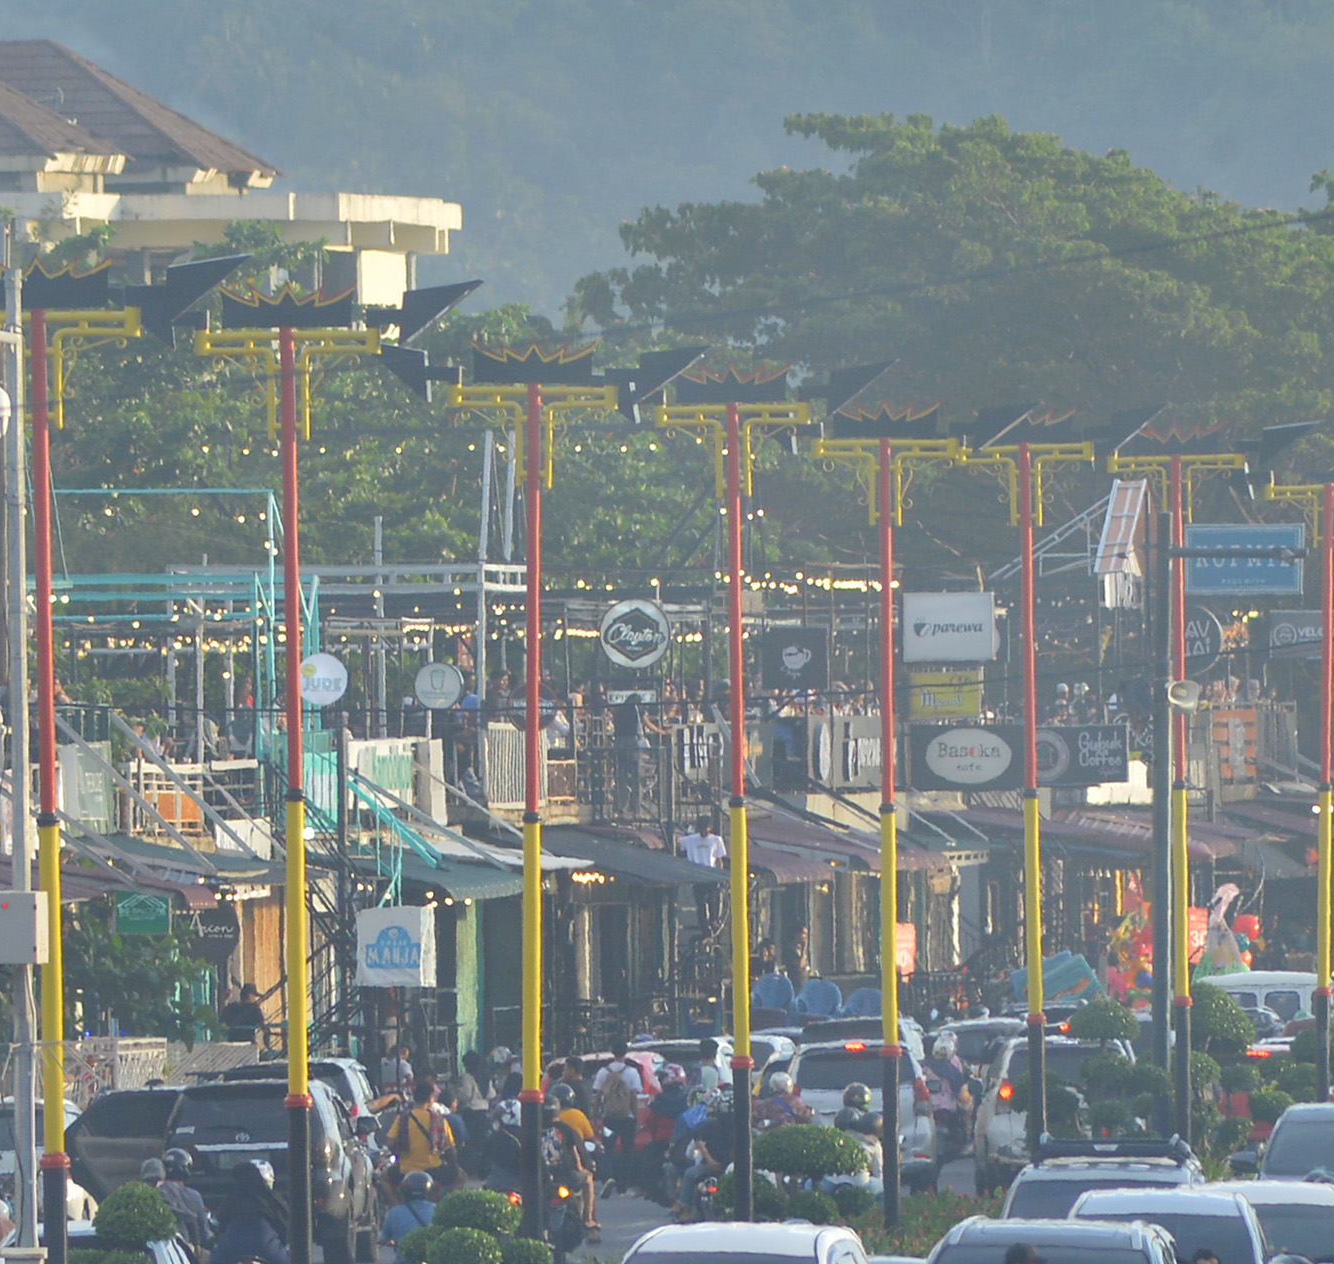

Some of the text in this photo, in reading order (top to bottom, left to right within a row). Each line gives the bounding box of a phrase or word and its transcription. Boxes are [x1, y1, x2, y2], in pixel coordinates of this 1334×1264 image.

[606, 622, 665, 646] Clayton
[931, 622, 984, 636] parewa
[1078, 731, 1122, 750] Gubuk
[956, 763, 982, 771] cafe
[1078, 750, 1122, 767] Coffee
